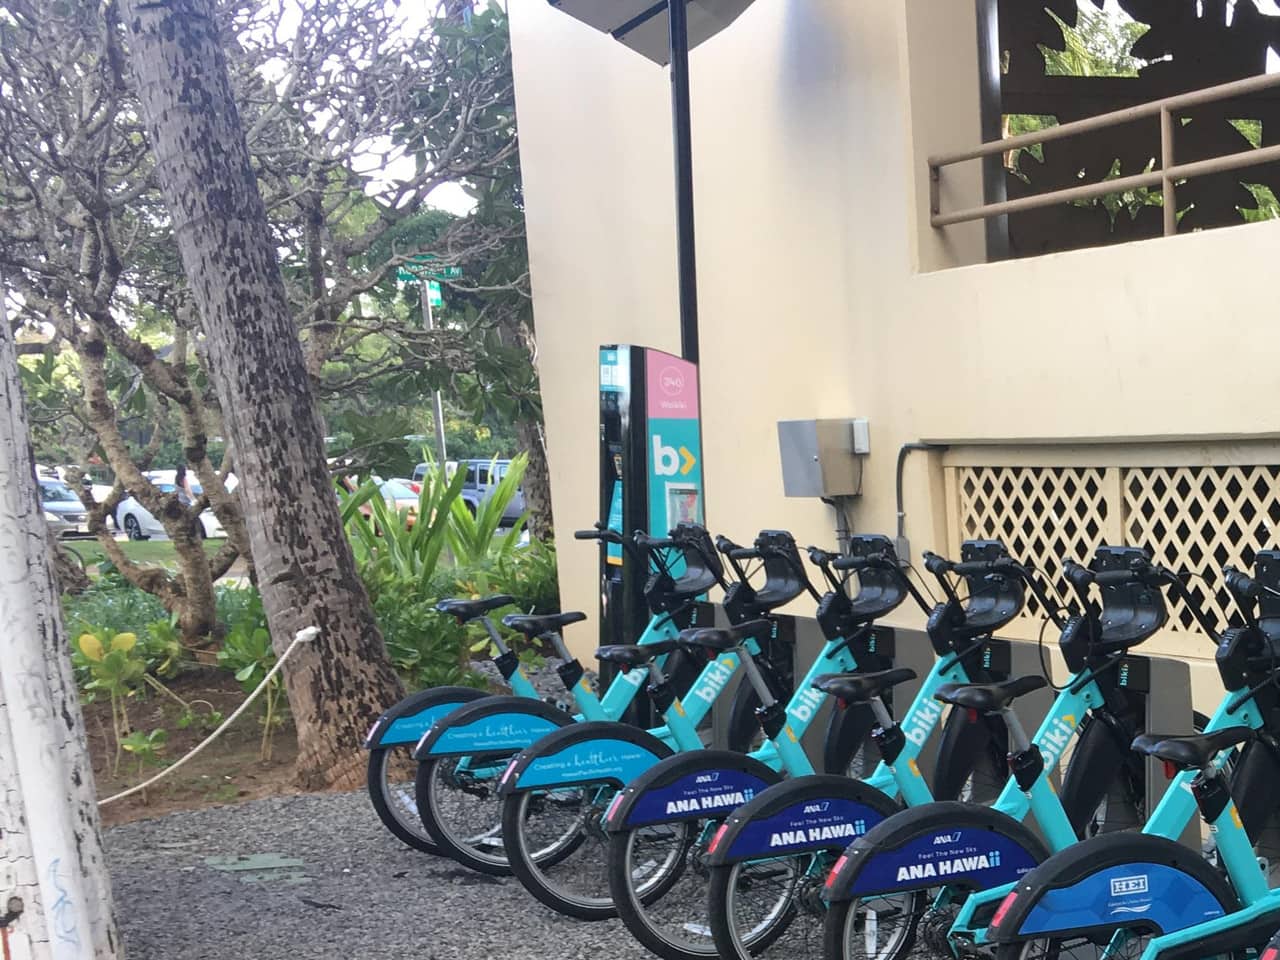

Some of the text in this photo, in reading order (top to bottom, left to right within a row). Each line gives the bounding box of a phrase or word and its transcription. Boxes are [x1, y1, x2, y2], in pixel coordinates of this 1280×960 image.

[694, 661, 731, 704] biki
[789, 688, 827, 723] bik
[904, 697, 942, 747] biki
[695, 775, 712, 783] ANA
[666, 799, 700, 815] ANA
[803, 805, 822, 813] ANA
[770, 829, 808, 847] ANA
[933, 834, 954, 845] ANA
[896, 862, 937, 882] ANA
[1114, 878, 1146, 893] HEI
